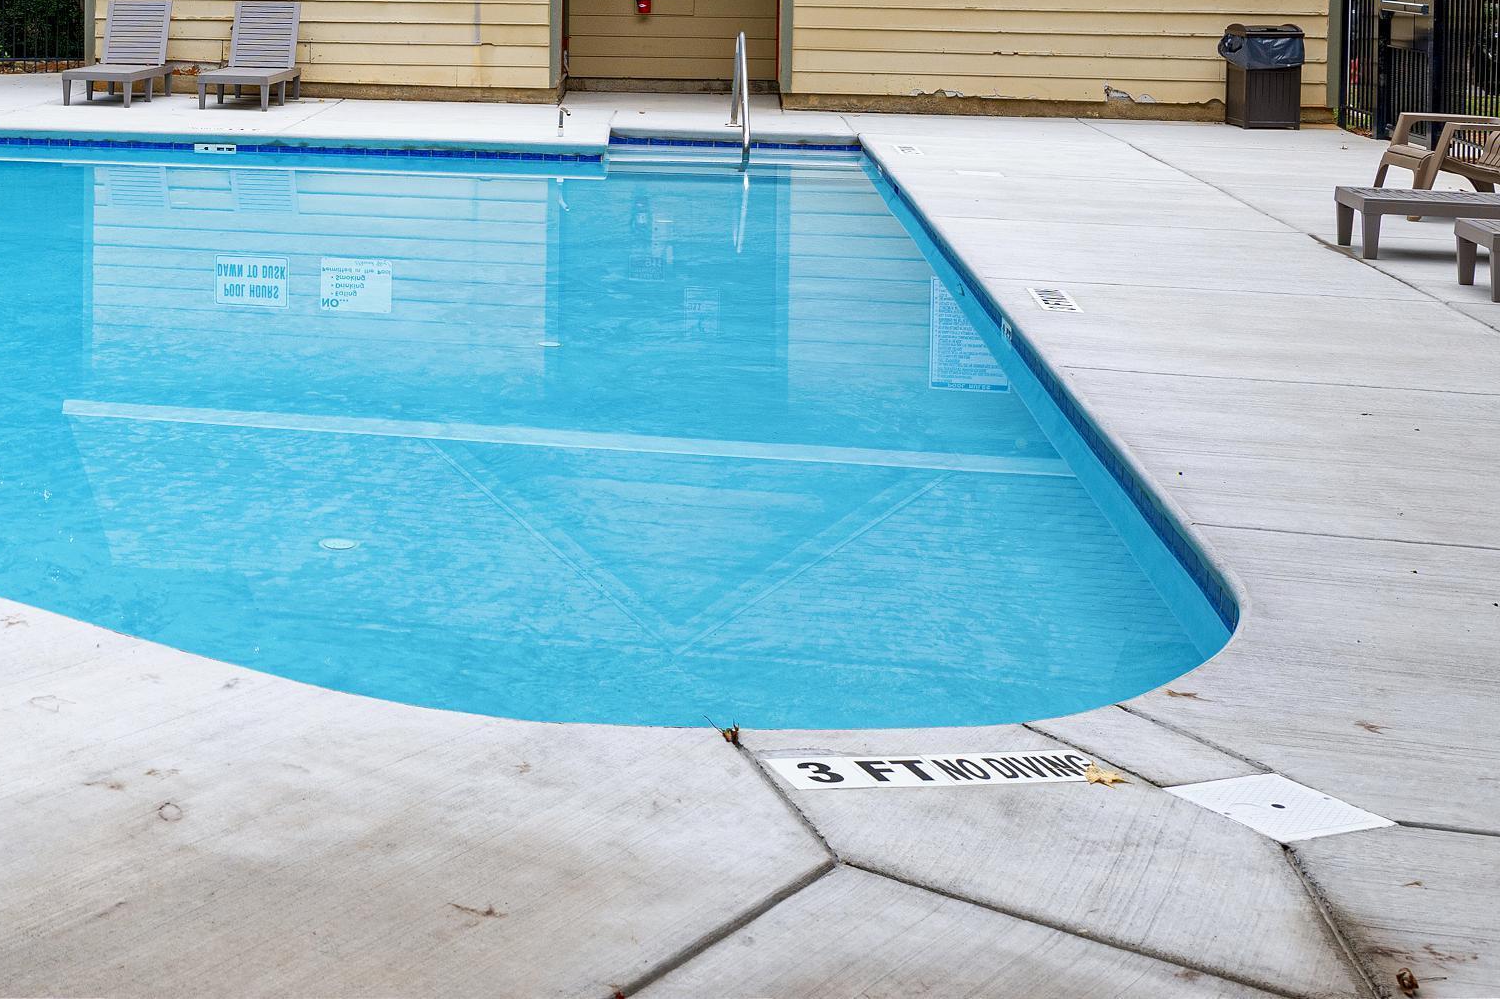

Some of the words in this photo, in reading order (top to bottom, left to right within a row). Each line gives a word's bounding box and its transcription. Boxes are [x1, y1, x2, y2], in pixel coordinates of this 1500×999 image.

[797, 762, 844, 783] 3
[854, 760, 935, 782] FT
[931, 758, 992, 780] NO
[982, 754, 1092, 779] DIVING
